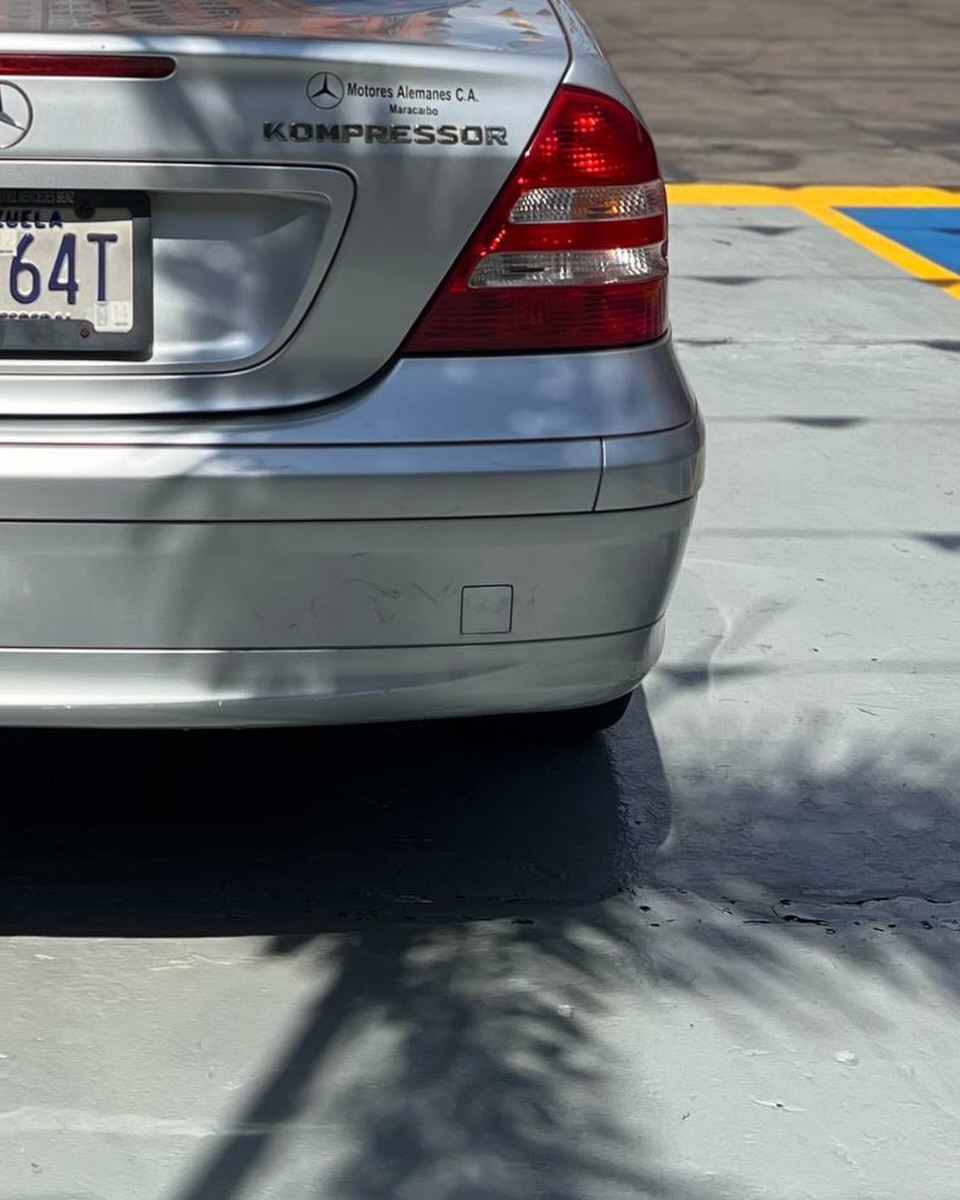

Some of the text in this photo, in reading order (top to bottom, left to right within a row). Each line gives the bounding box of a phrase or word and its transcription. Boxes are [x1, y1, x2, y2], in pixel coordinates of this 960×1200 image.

[347, 82, 480, 103] Motores Alemanes C.A.
[388, 103, 439, 117] Maracaibo
[262, 120, 509, 147] KOMPRESSOR
[9, 232, 119, 305] 64T
